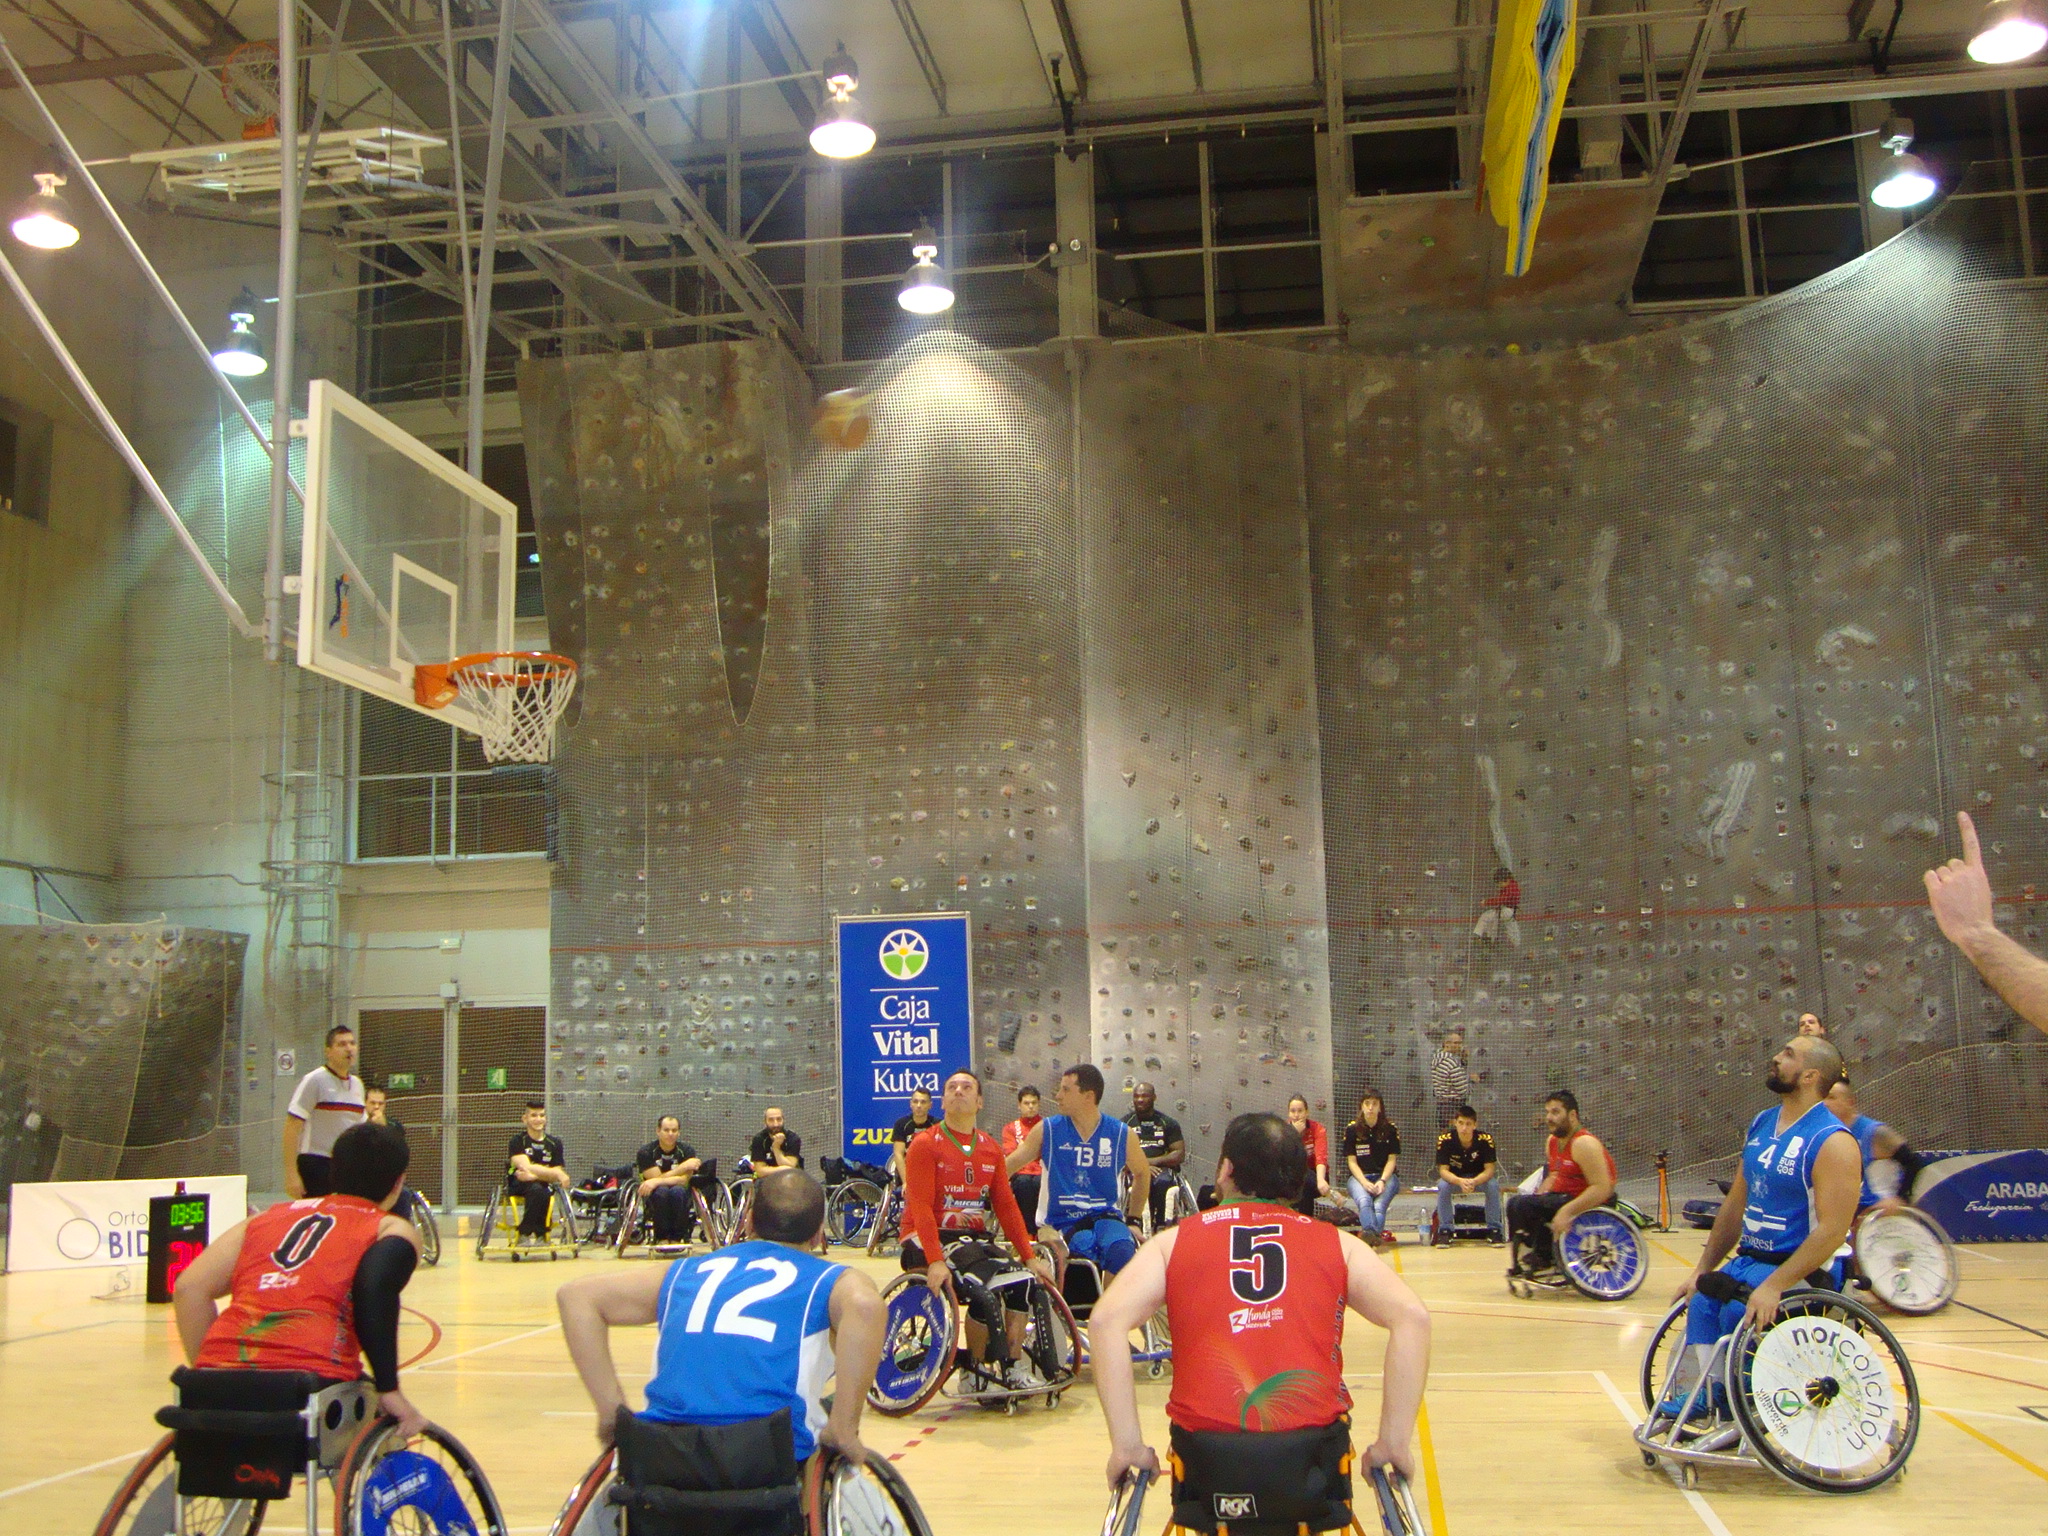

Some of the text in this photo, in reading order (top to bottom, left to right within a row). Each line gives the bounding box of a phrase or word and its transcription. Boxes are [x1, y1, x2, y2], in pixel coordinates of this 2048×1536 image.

[880, 995, 930, 1024] Caja
[873, 1028, 939, 1056] Vital
[874, 1068, 939, 1093] Kutxa
[1074, 1146, 1095, 1167] 13
[1757, 1144, 1777, 1169] 4
[965, 1166, 974, 1185] 6
[944, 1184, 964, 1193] Vital
[1986, 1182, 2048, 1198] ARABA
[108, 1211, 149, 1226] Orto
[270, 1211, 337, 1272] 0
[1230, 1224, 1287, 1305] 5
[685, 1256, 798, 1343] 12
[1760, 1387, 1789, 1434] villaverde
